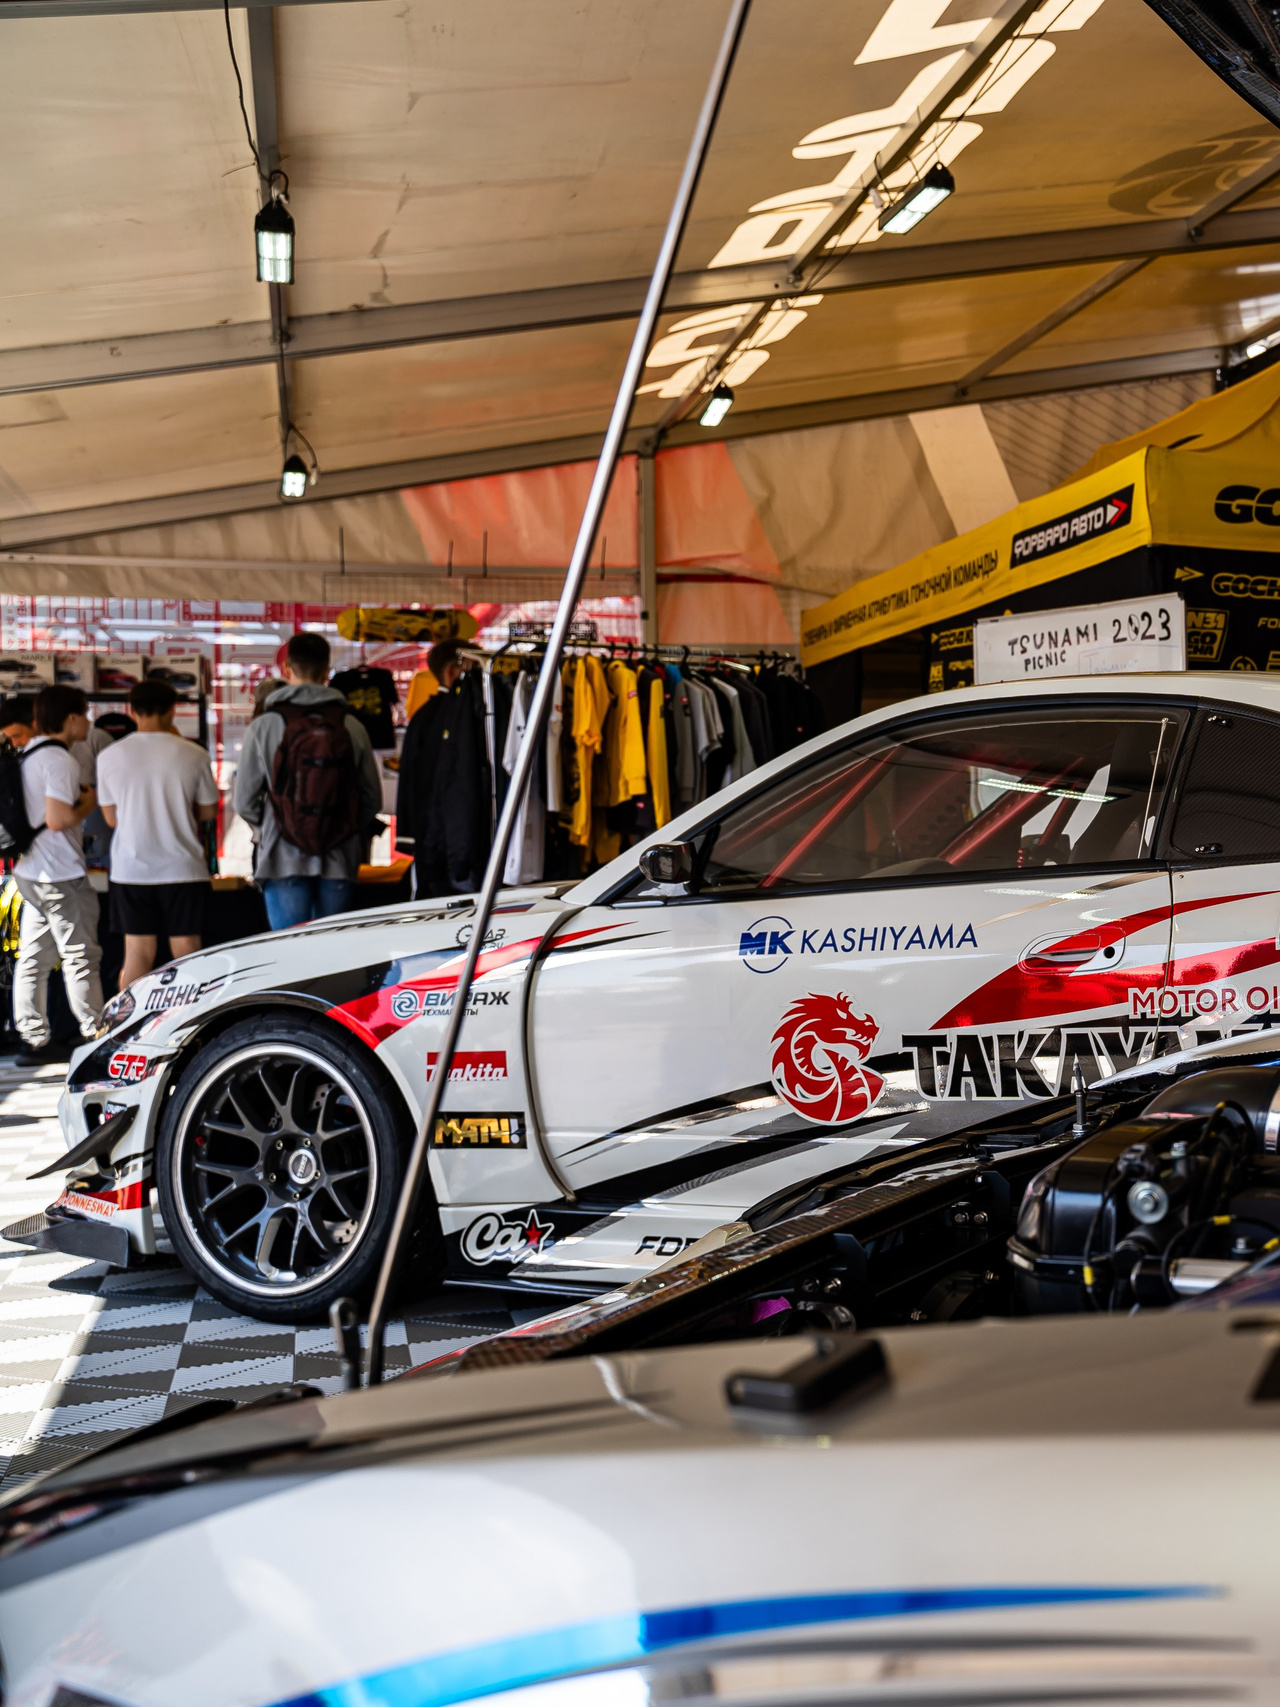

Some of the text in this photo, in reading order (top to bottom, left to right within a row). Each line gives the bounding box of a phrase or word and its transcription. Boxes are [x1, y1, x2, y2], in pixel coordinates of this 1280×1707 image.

[1013, 506, 1104, 559] ФОРВАРД АВТО
[911, 566, 952, 604] ГОНОЧНОЙ
[954, 549, 998, 588] КОМАНДЫ
[1008, 623, 1098, 656] TSUNAMI
[1024, 650, 1066, 672] PICNIC
[738, 924, 978, 958] MK KASHIYAMA
[144, 983, 208, 1010] MAHLE
[1132, 987, 1240, 1018] MOTOR
[64, 1192, 117, 1218] JONNESWAY
